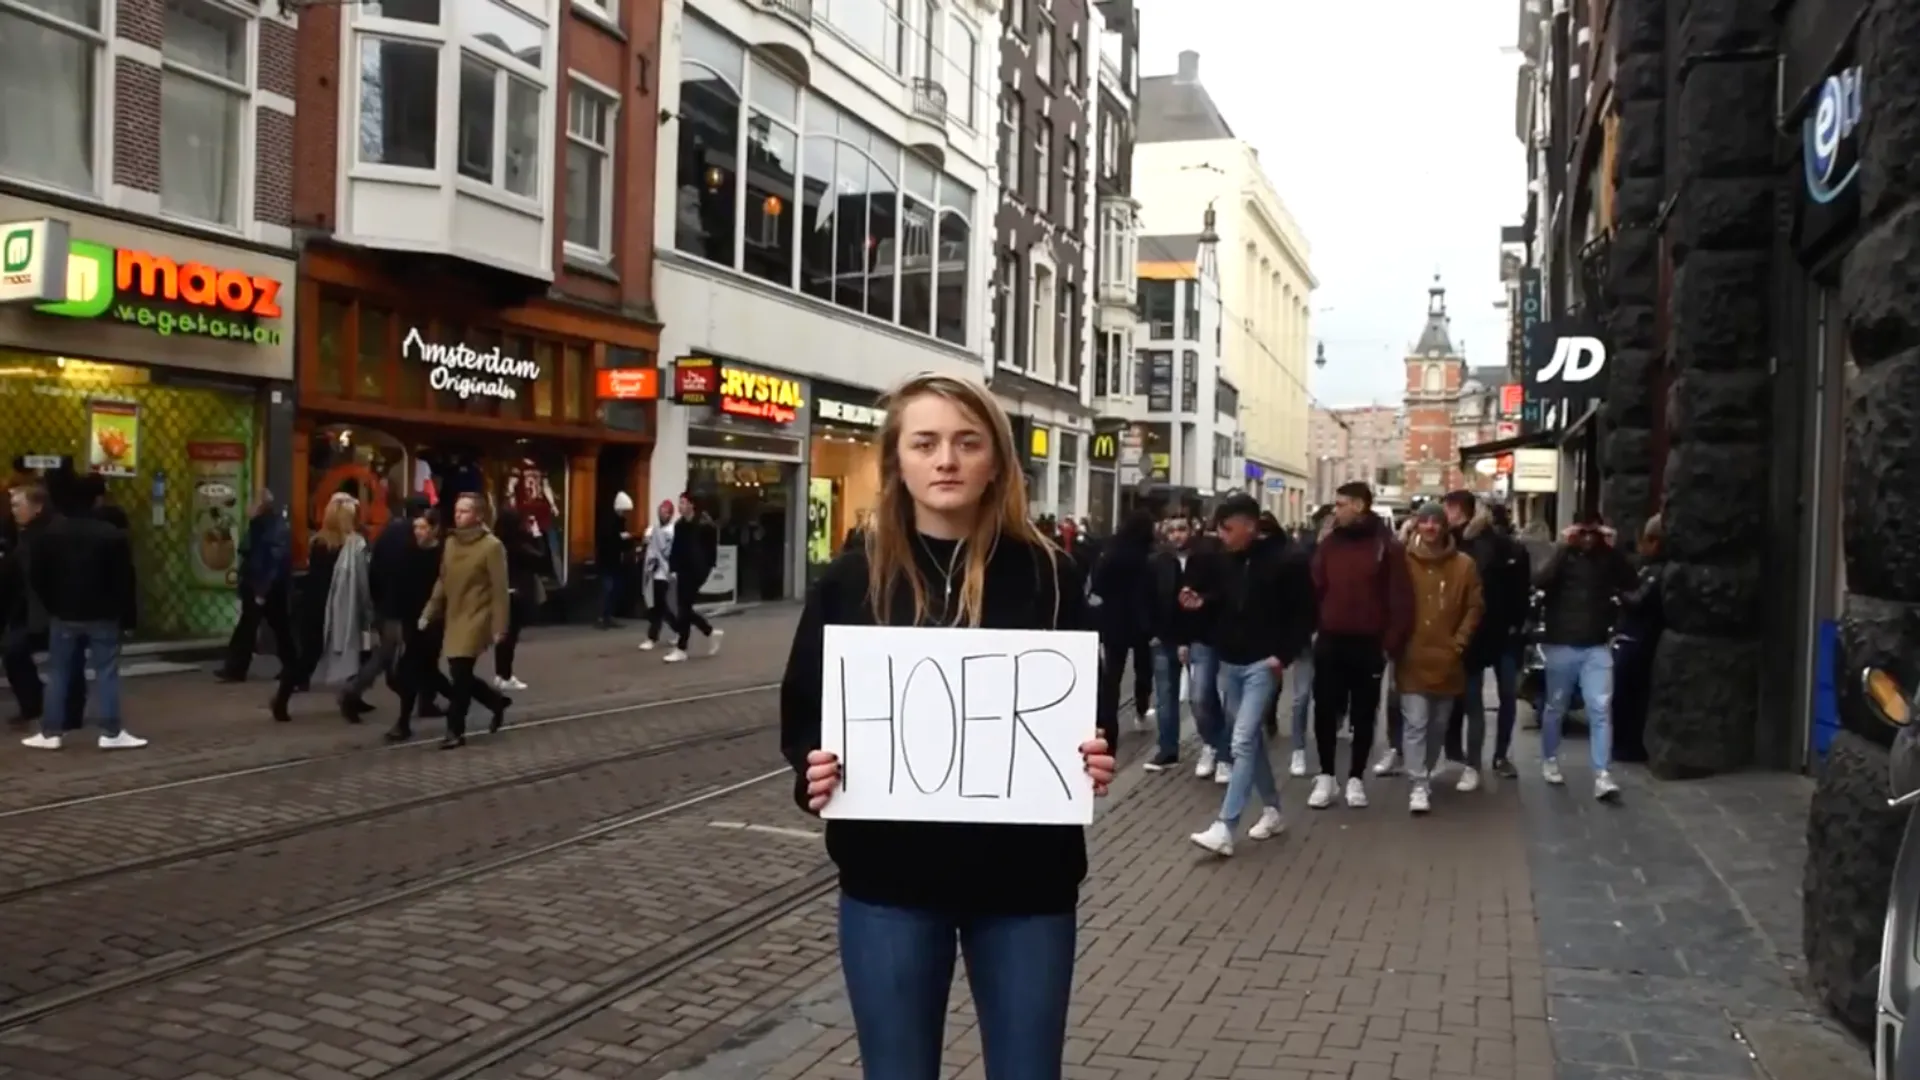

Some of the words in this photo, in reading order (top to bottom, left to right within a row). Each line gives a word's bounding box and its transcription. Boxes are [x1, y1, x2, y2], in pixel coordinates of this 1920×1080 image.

[117, 248, 282, 318] maoz
[116, 303, 282, 345] vegetarian
[402, 327, 540, 379] Amsterdam
[1536, 336, 1606, 382] JD
[430, 366, 517, 399] Originals
[840, 649, 1077, 801] HOER
